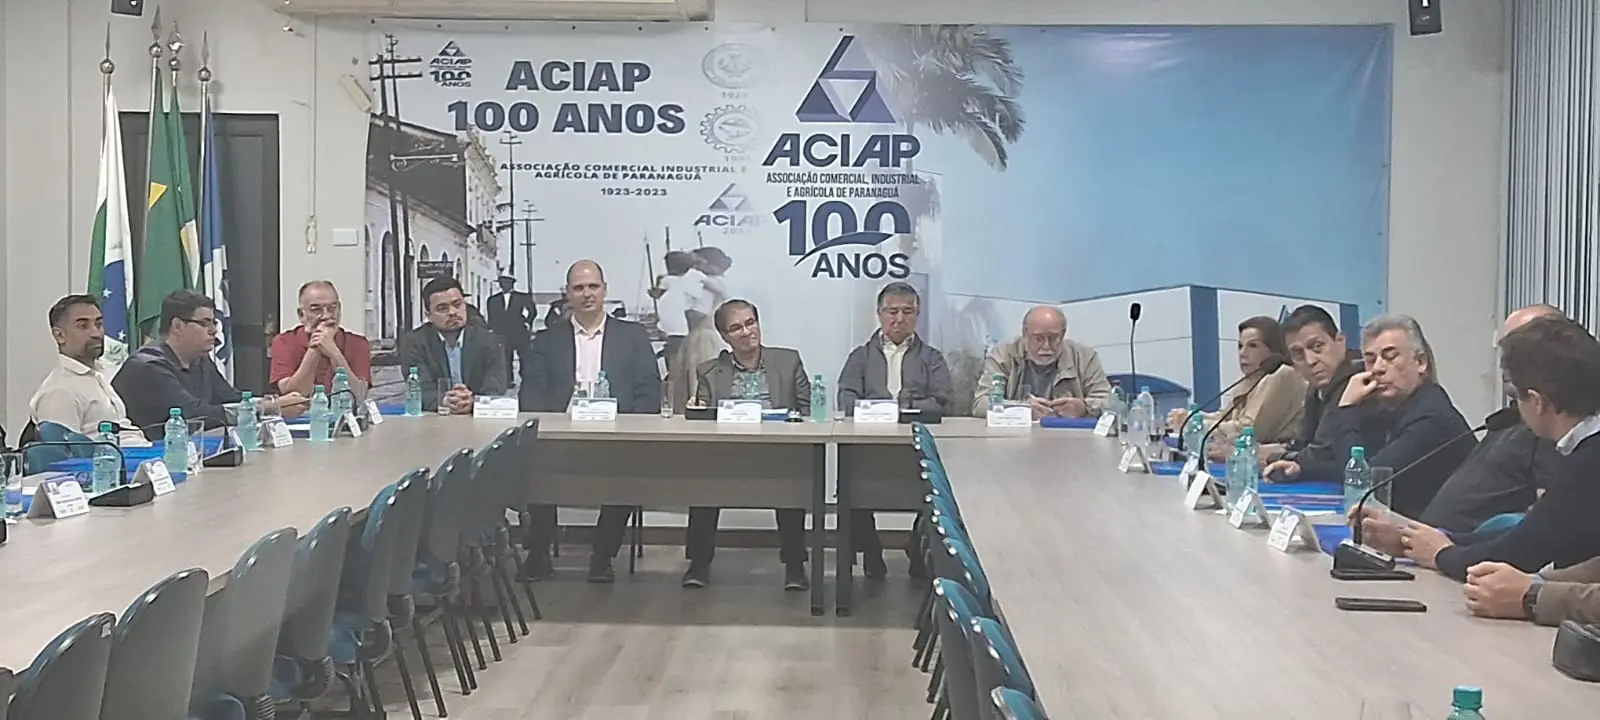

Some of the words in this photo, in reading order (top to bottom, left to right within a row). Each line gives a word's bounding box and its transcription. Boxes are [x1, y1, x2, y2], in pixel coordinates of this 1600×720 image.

[430, 71, 471, 81] 100
[505, 61, 651, 92] ACIAP
[448, 101, 540, 132] 100
[553, 103, 686, 134] ANOS
[762, 133, 921, 168] ACIAP
[500, 162, 580, 173] ASSOCIAÇÃO
[584, 164, 657, 172] COMERCIAL
[661, 165, 736, 173] INDUSTRIAL
[603, 172, 619, 180] DE
[766, 172, 818, 185] ASSOCIAÇÃO
[820, 173, 869, 185] COMERCIAL,
[871, 174, 920, 185] INDUSTRIAL
[600, 187, 669, 197] 1923-2023
[787, 186, 792, 198] E
[794, 185, 834, 198] AGRÍCOLA
[836, 187, 847, 198] DE
[849, 187, 900, 198] PARANAGUÁ
[772, 200, 912, 256] 100
[811, 252, 911, 279] ANOS
